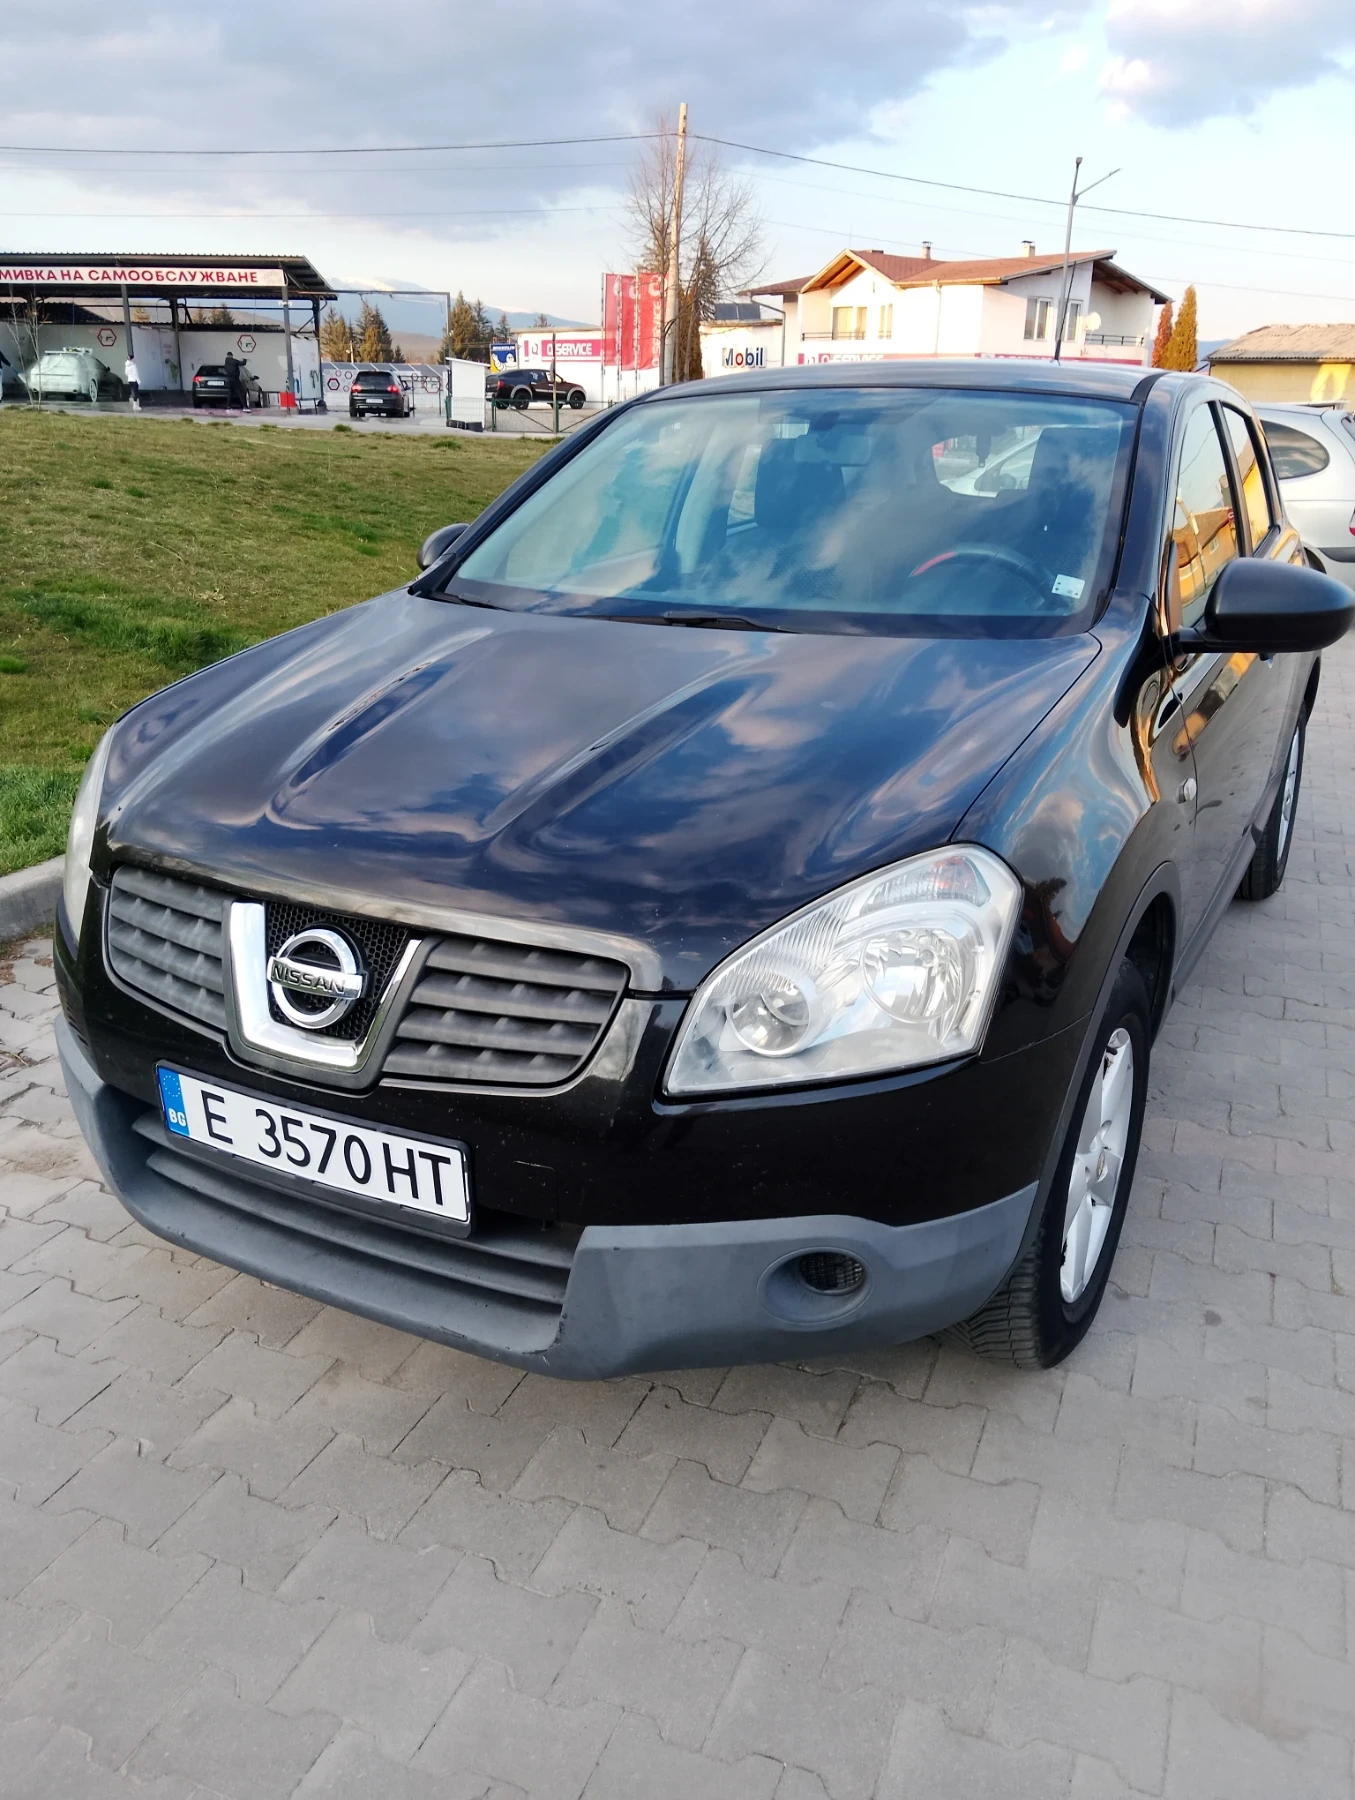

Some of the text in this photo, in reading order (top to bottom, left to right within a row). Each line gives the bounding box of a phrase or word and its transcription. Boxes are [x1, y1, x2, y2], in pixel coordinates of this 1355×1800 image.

[60, 269, 84, 281] НА
[88, 269, 258, 282] САМООБСЛУЖВАНЕ
[722, 347, 764, 367] Mobil
[271, 963, 345, 995] NISSAN
[168, 1108, 187, 1127] BG
[201, 1089, 234, 1145] E
